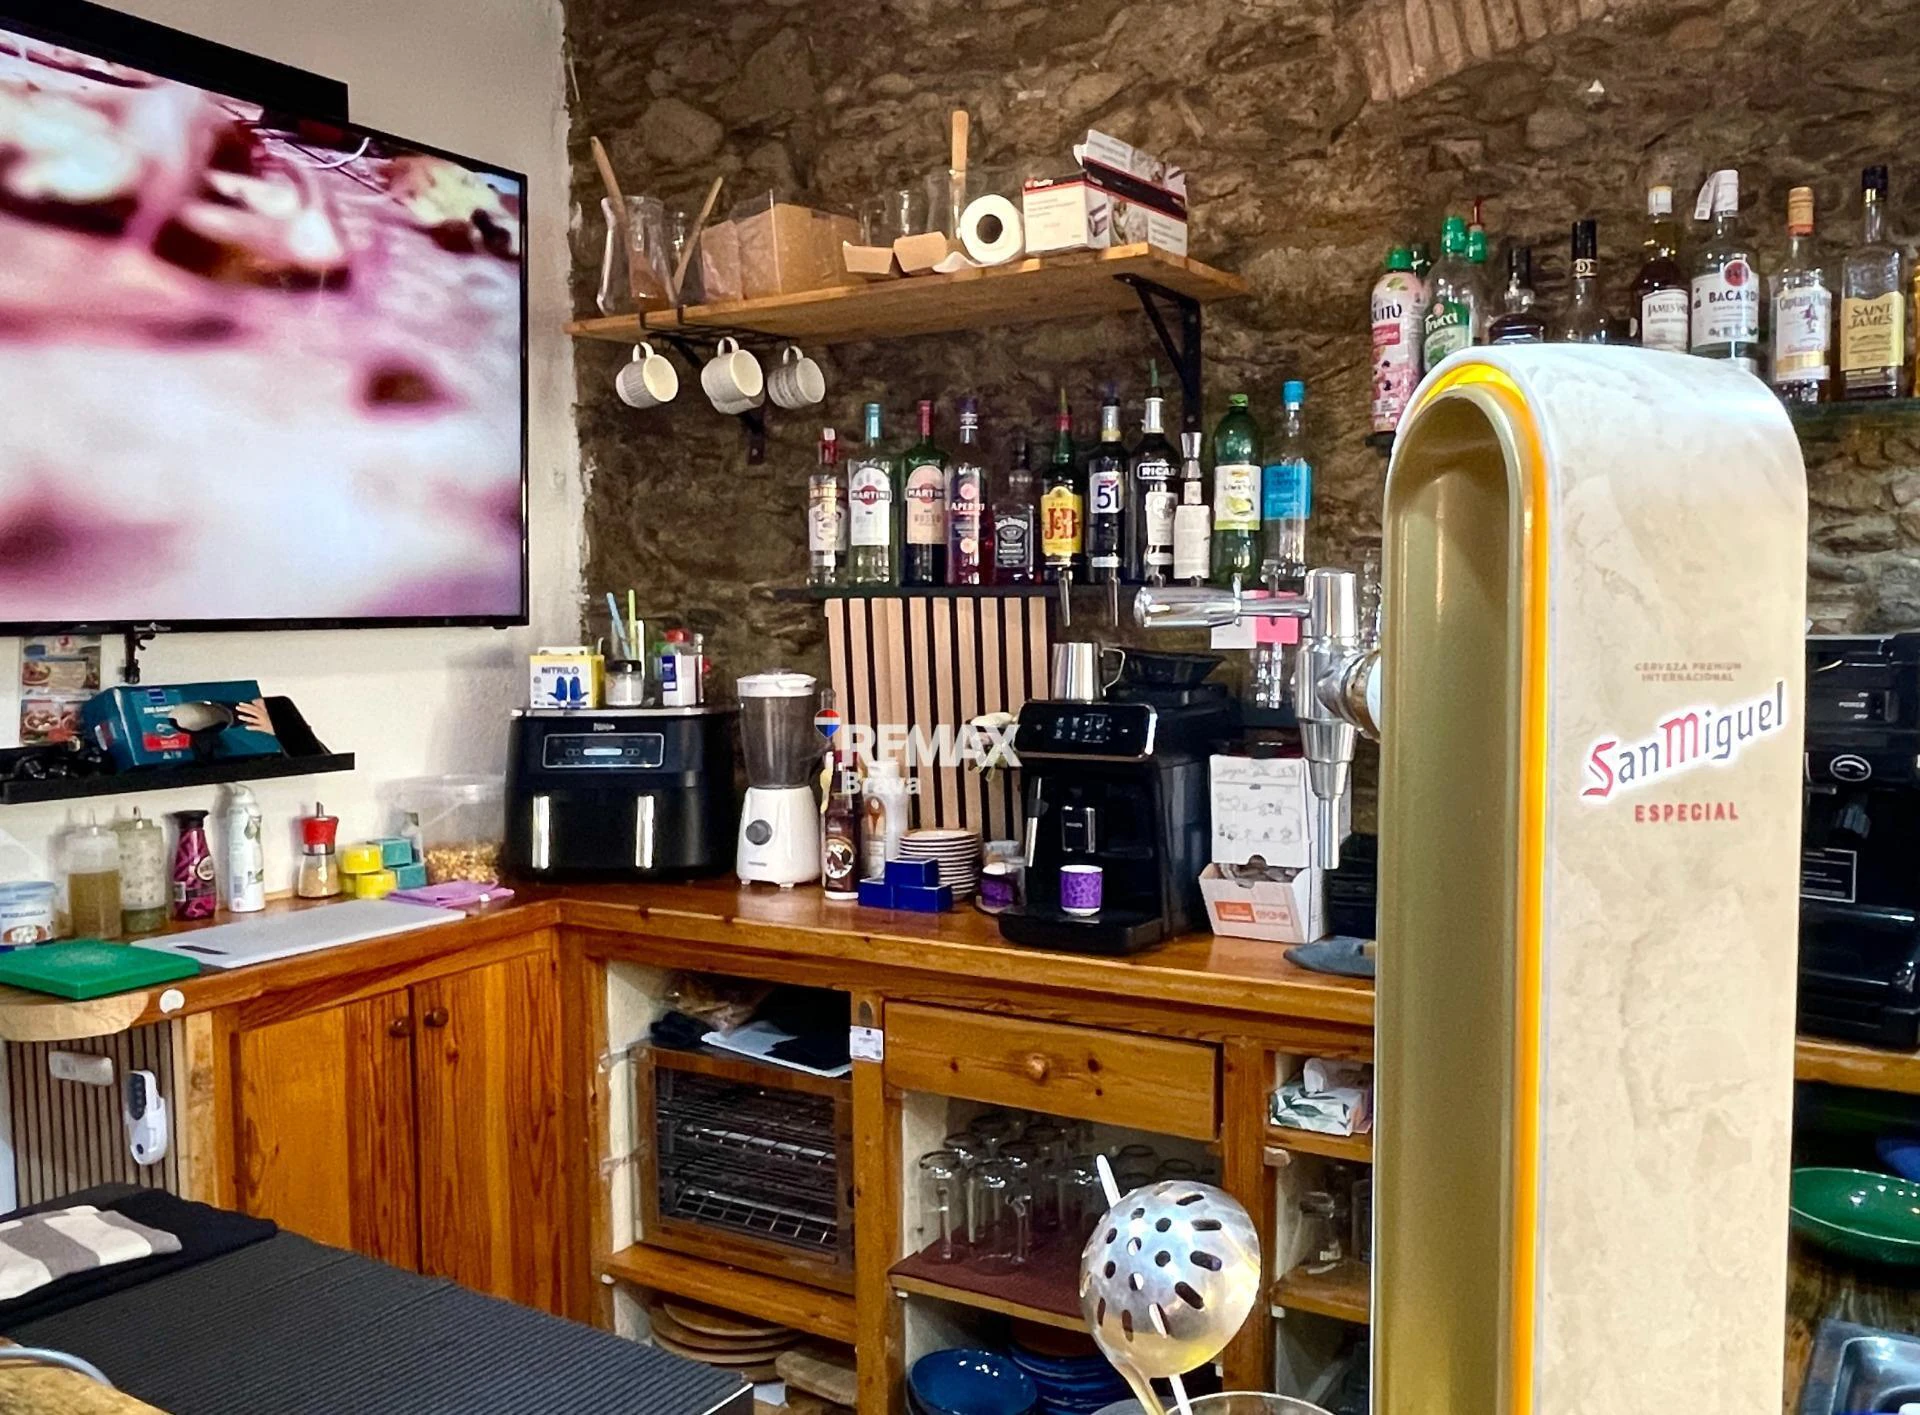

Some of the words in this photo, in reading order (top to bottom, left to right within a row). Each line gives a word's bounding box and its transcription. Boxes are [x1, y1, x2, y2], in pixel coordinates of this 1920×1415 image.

[1853, 303, 1892, 316] SAINT
[1848, 313, 1894, 330] JAMES
[1097, 484, 1119, 509] 51
[1045, 508, 1082, 540] J&B
[541, 666, 579, 675] NITRILO
[1634, 662, 1688, 672] CERVEZA
[1692, 662, 1742, 671] PREMIUM
[1641, 672, 1735, 682] INTERNACIONAL
[1634, 802, 1739, 823] ESPECIAL
